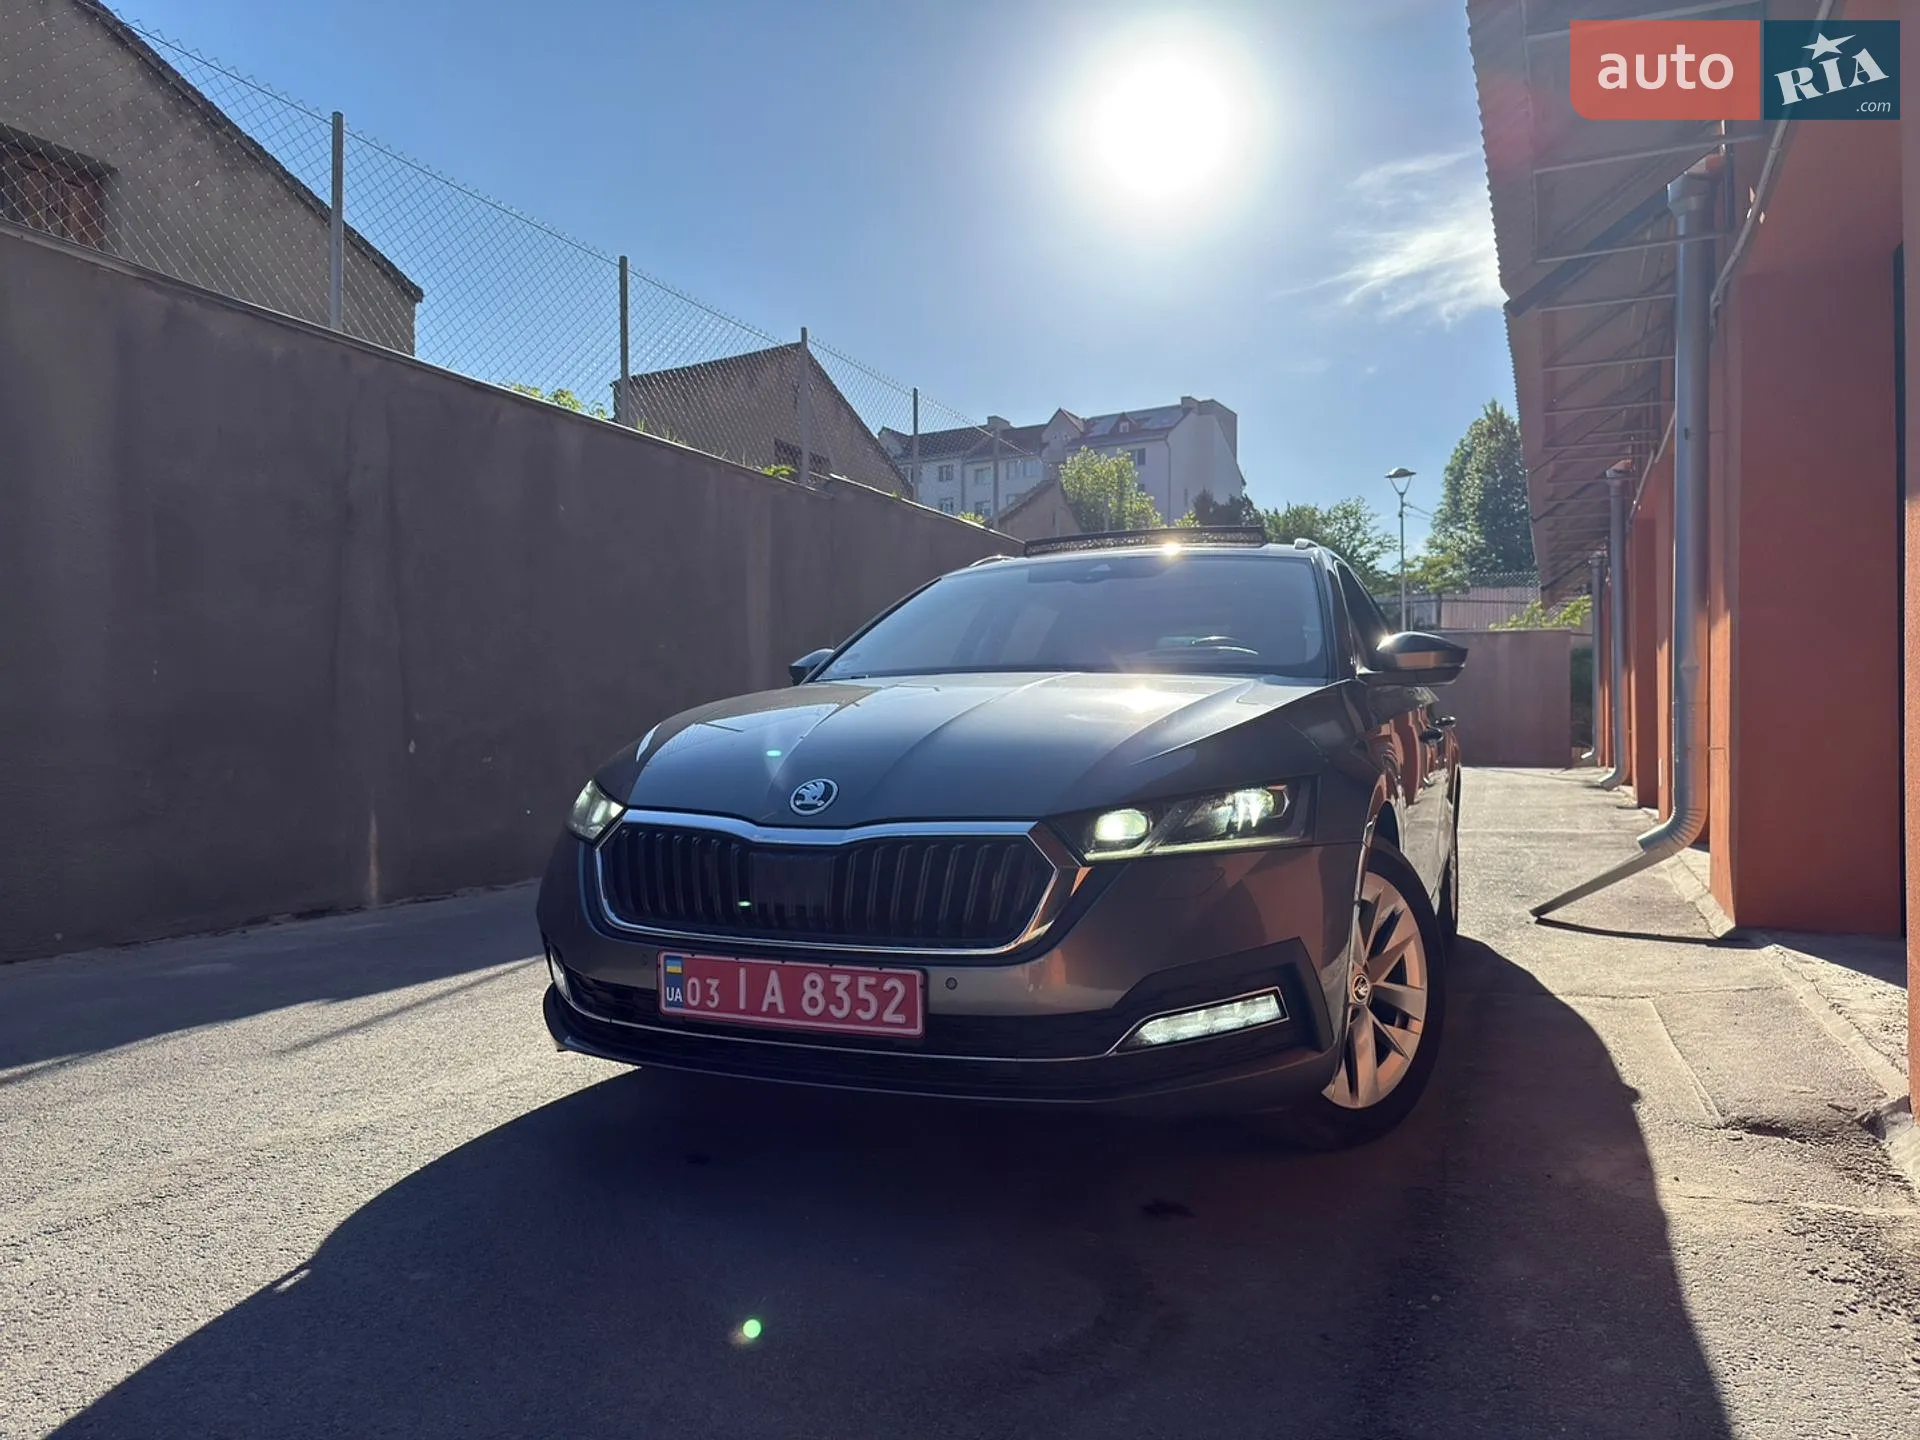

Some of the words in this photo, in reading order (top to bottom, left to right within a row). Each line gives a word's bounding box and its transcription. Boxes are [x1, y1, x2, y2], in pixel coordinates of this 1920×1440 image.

[666, 986, 683, 1002] UA
[687, 977, 720, 1008] 03
[801, 971, 907, 1024] 8352
